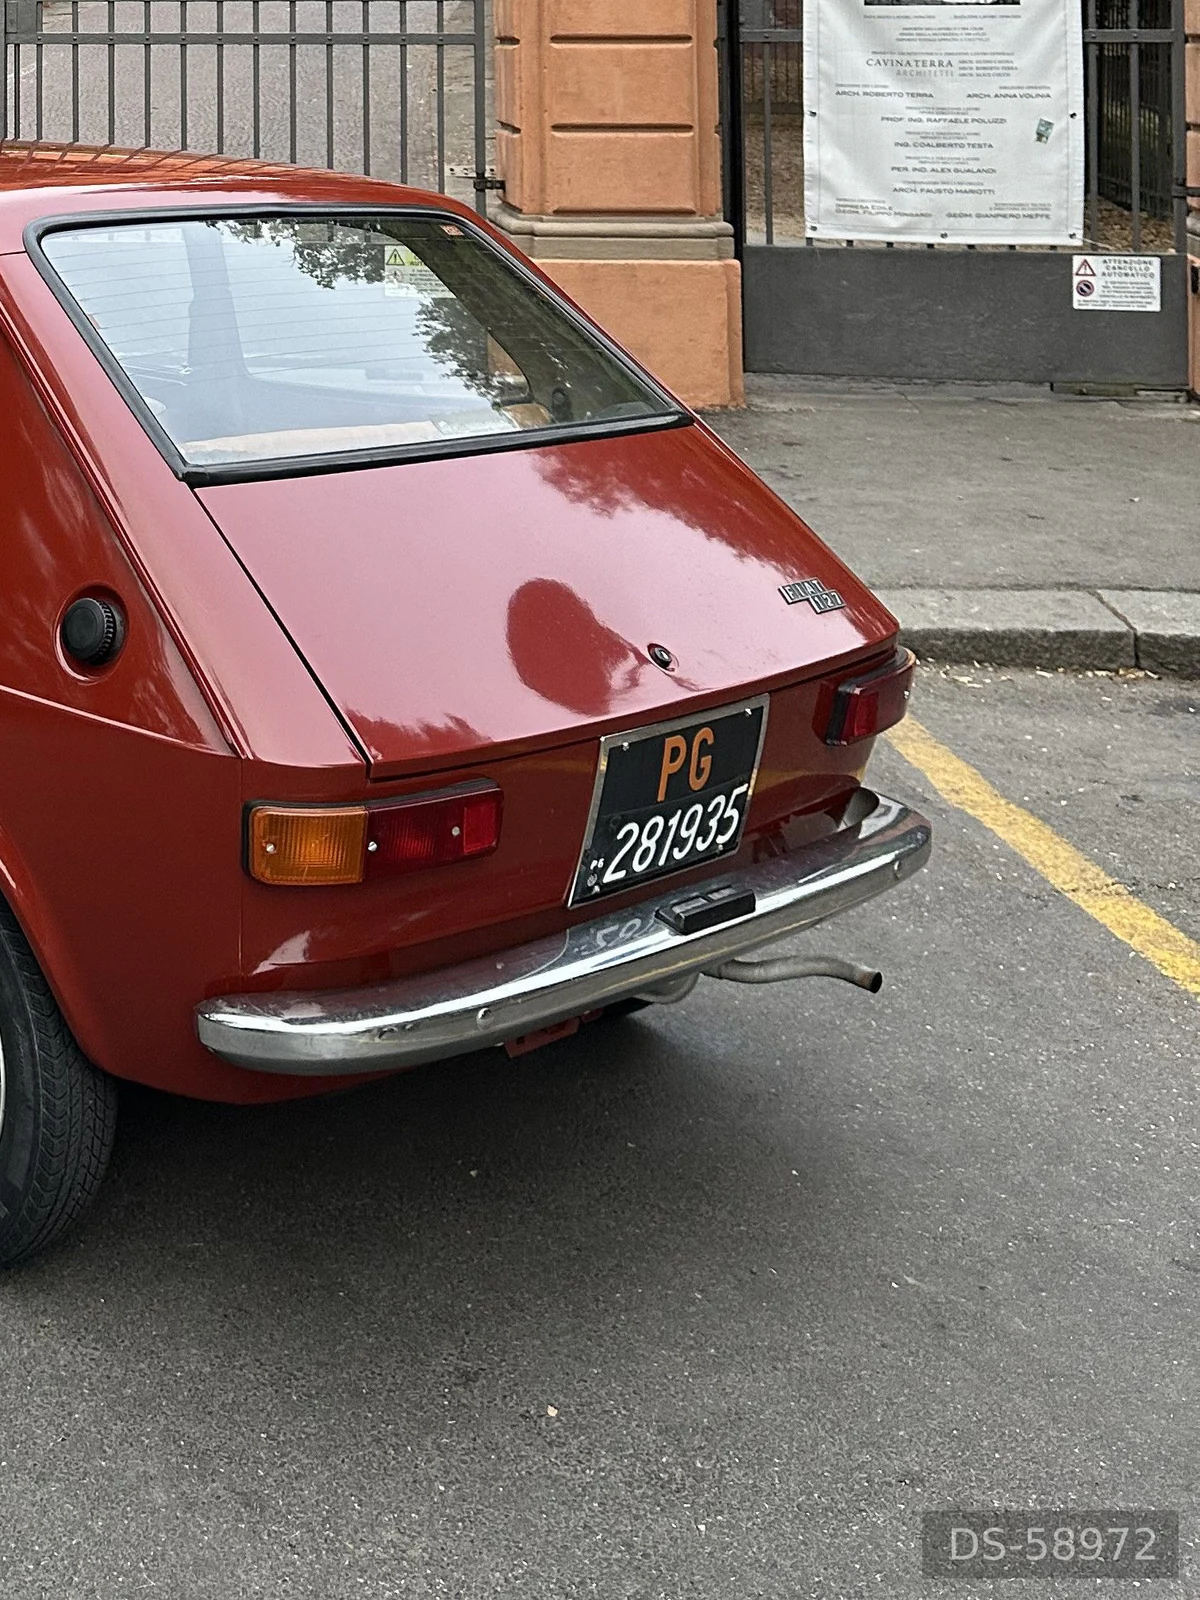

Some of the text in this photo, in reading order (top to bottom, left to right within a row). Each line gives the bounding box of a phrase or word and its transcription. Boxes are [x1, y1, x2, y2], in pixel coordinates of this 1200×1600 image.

[1102, 258, 1154, 266] ATTENZIONE
[784, 579, 823, 600] FIAT
[813, 591, 842, 610] 127
[657, 727, 716, 802] PG
[602, 782, 749, 883] 281935
